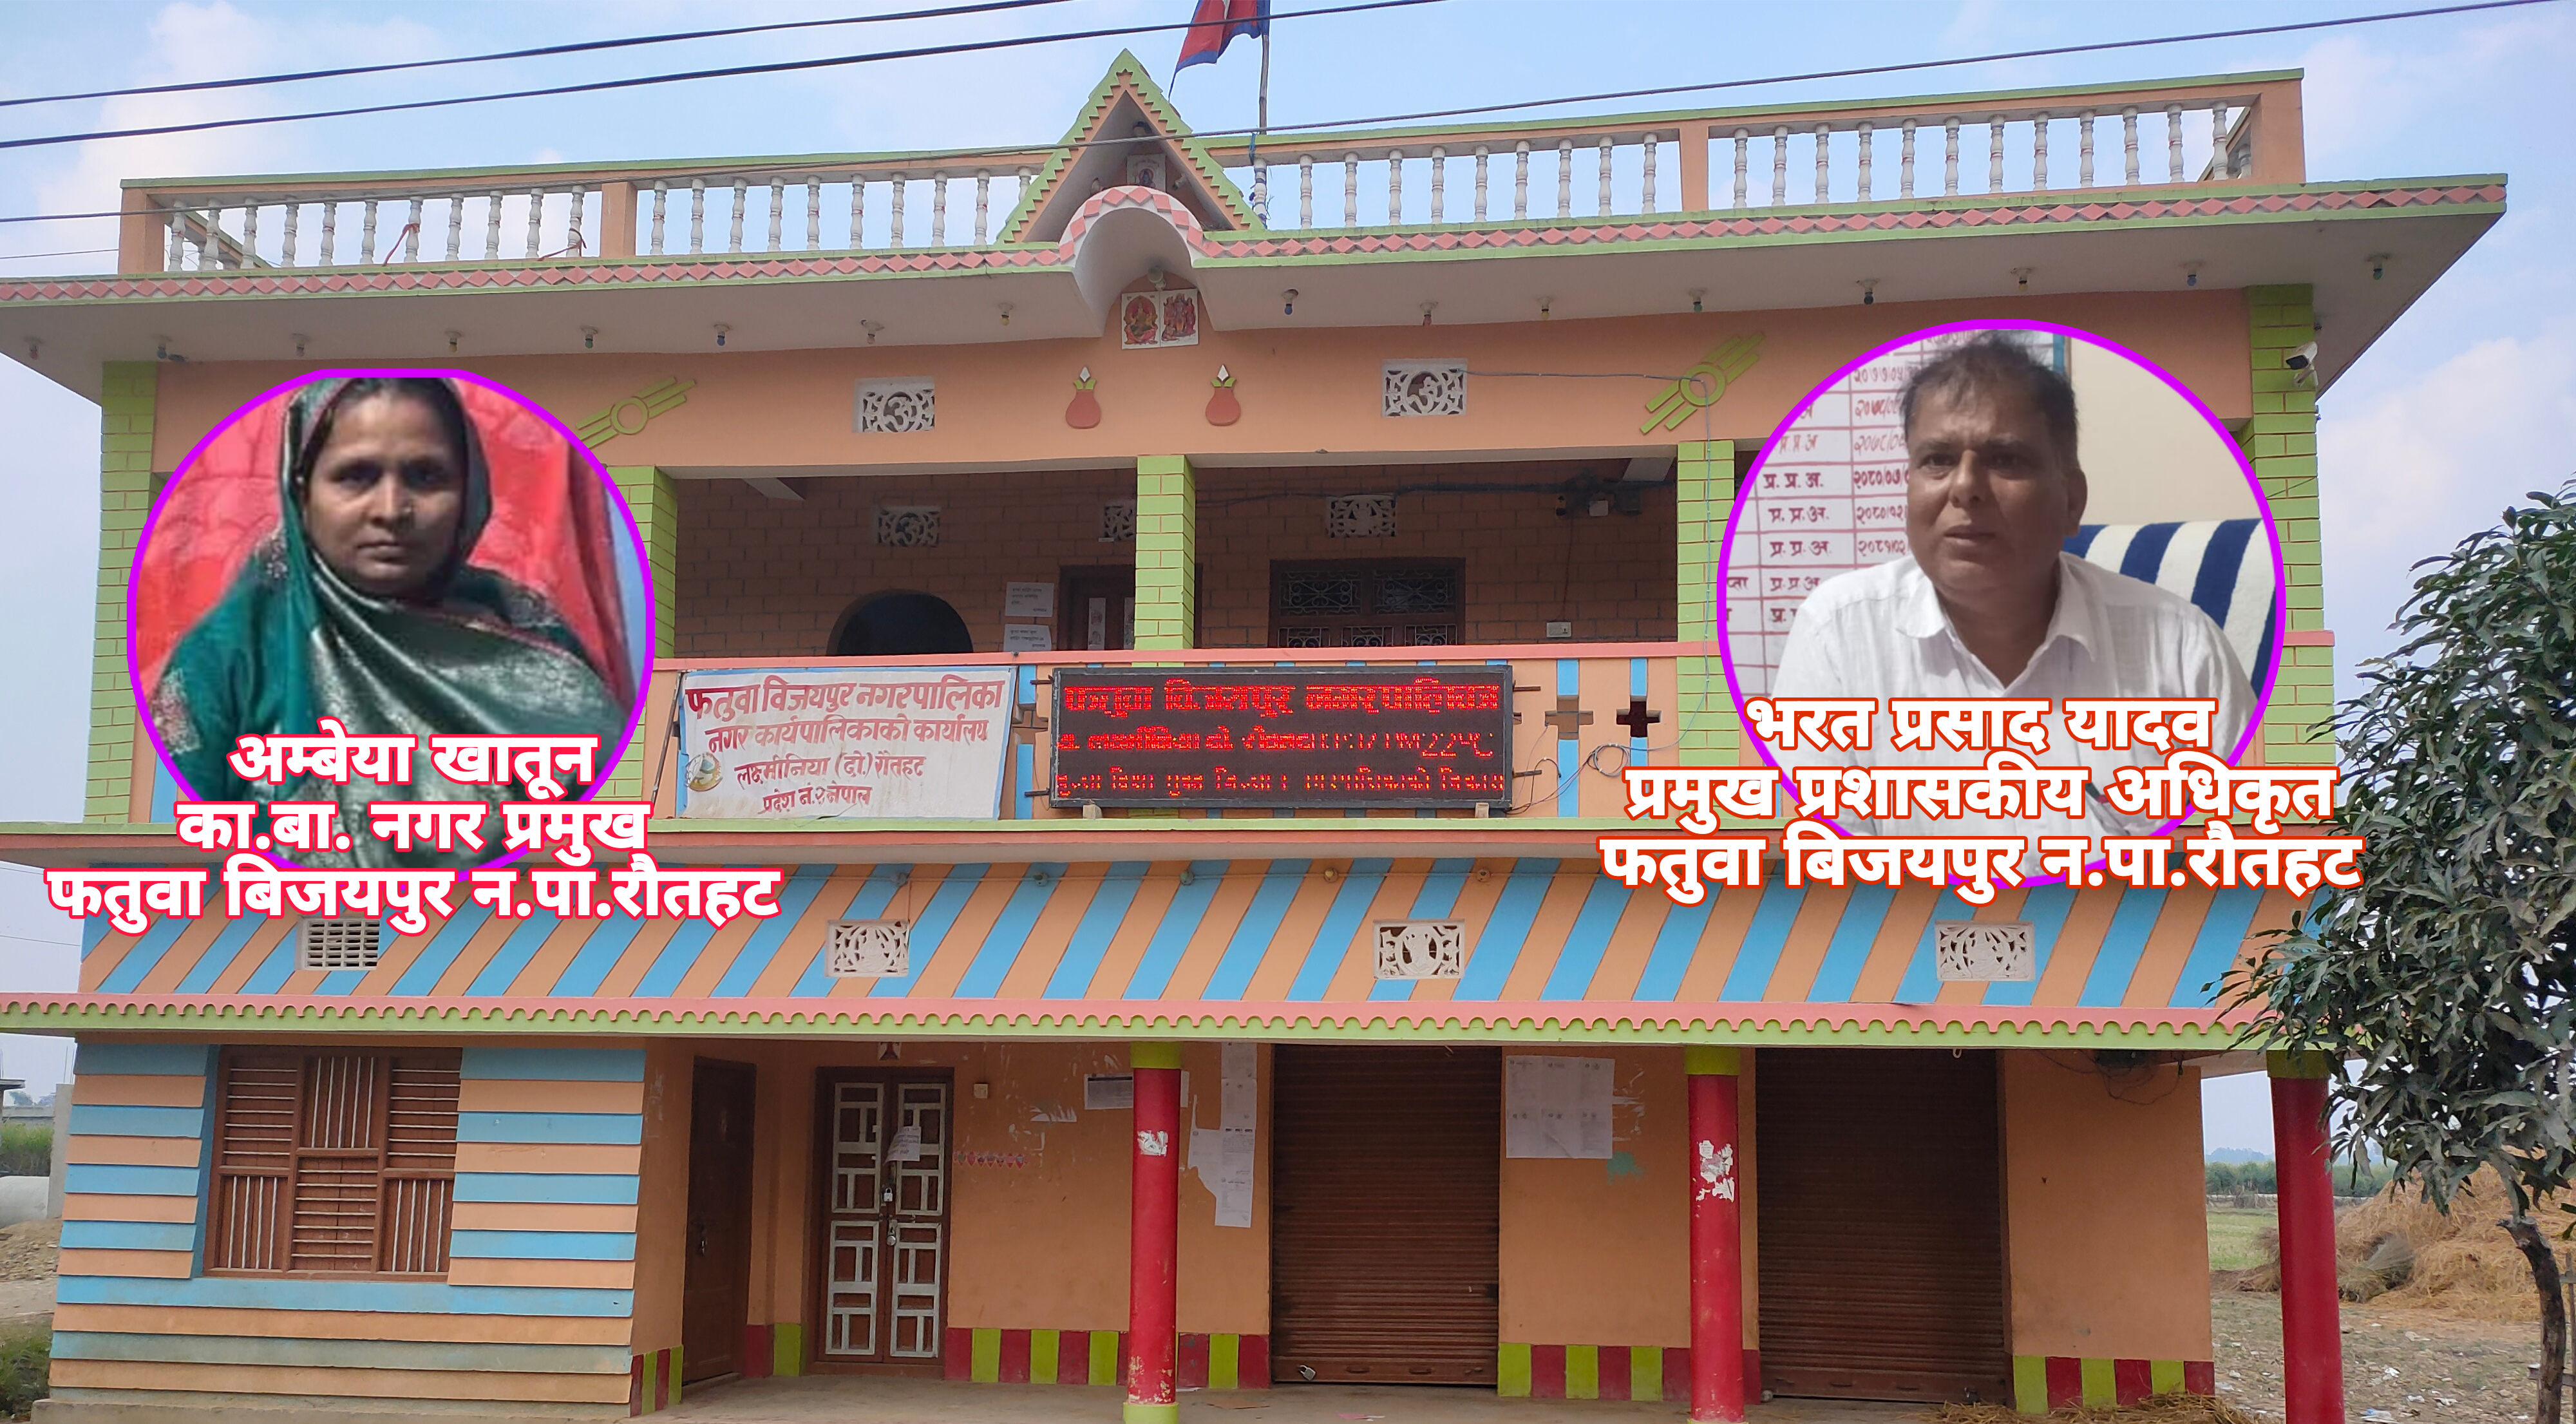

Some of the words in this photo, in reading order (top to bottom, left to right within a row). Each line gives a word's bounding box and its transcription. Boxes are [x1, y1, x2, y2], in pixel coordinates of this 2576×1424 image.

[685, 684, 761, 722] फतुवा
[761, 674, 857, 713] विजयपुर
[857, 674, 1006, 712] नगरपालिका
[705, 725, 750, 753] नगर
[755, 713, 911, 746] कार्यपालिकाको
[913, 713, 990, 746] कार्यालय
[827, 780, 873, 807] नेपाल
